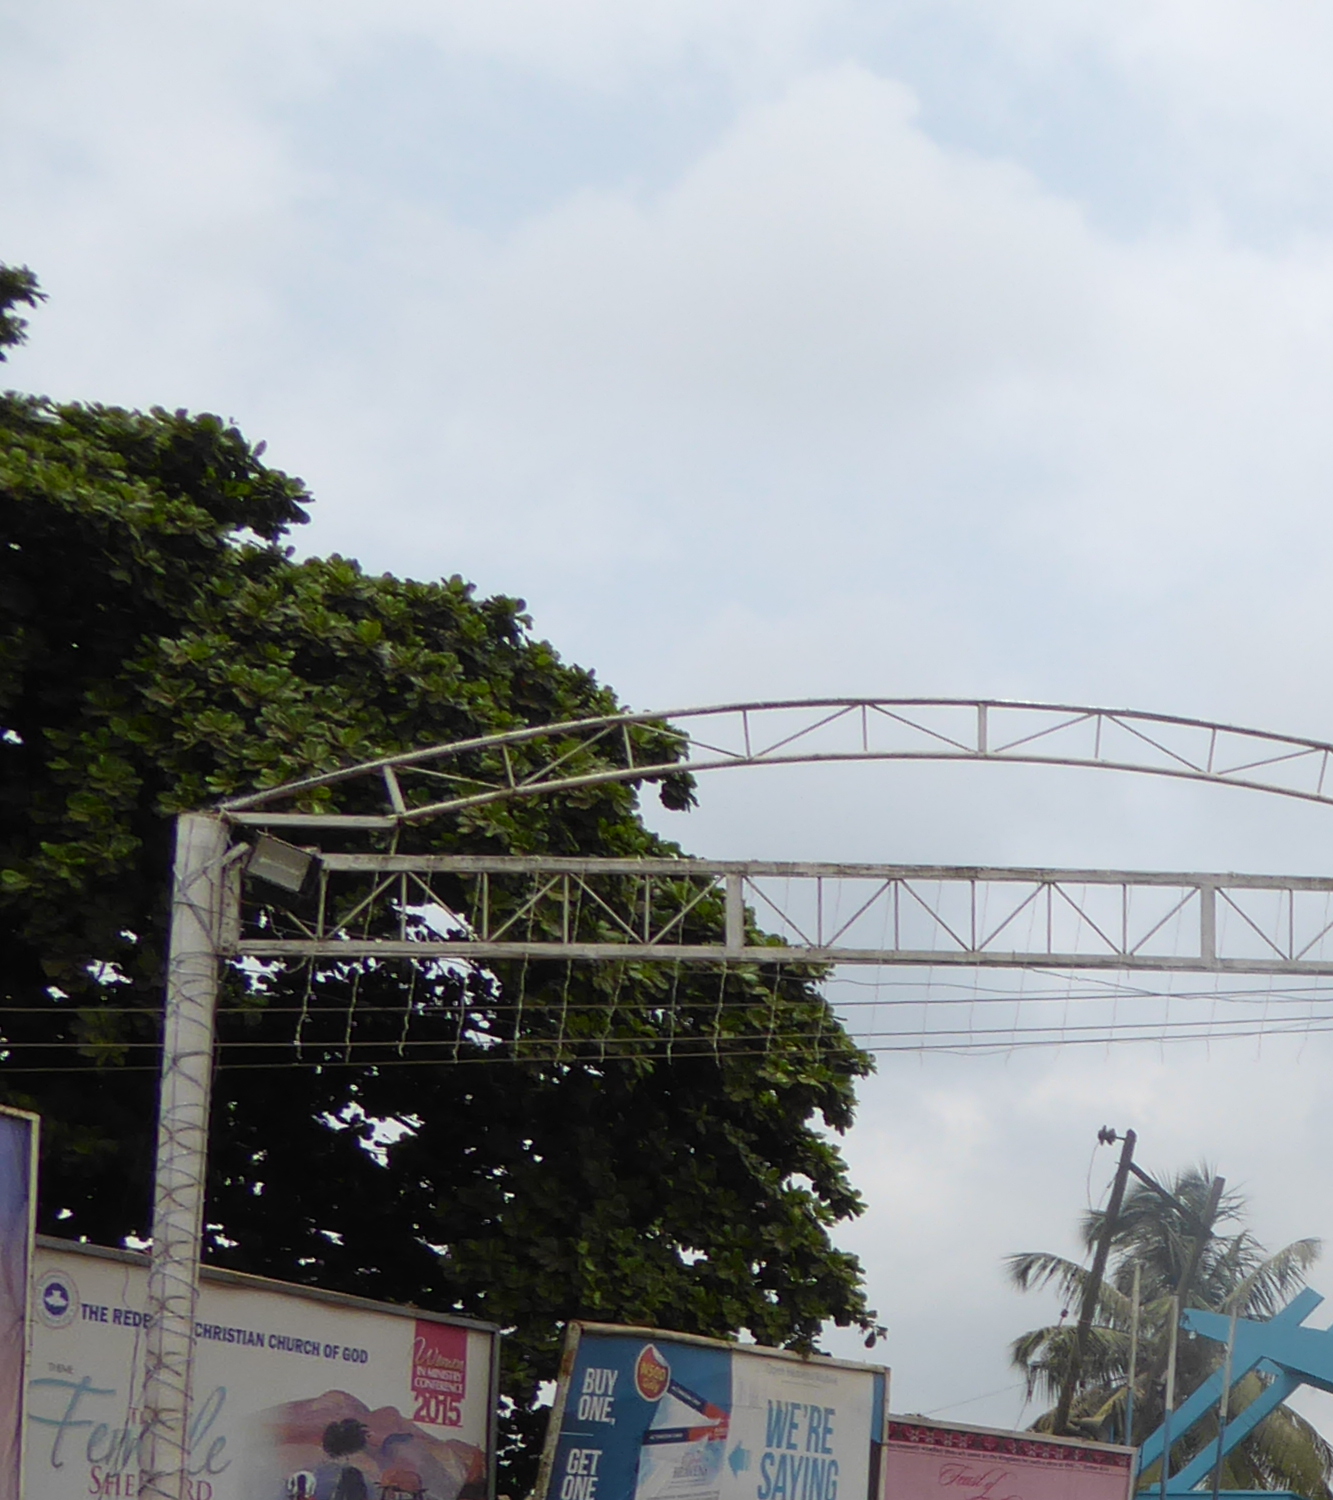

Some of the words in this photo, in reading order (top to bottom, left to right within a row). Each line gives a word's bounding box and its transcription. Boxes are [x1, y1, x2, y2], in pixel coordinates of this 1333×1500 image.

[81, 1303, 108, 1323] THE
[195, 1322, 265, 1348] CHRISTIAN
[268, 1334, 320, 1357] CHURCH
[323, 1344, 339, 1359] OF
[342, 1347, 368, 1364] GOD
[414, 1336, 464, 1371] Women
[414, 1377, 463, 1393] CONFERENCE
[417, 1366, 426, 1376] IN
[582, 1367, 618, 1396] BUY
[413, 1390, 463, 1428] 2015
[577, 1395, 617, 1426] ONE,
[765, 1399, 836, 1455] WE'RE
[566, 1448, 603, 1476] GET
